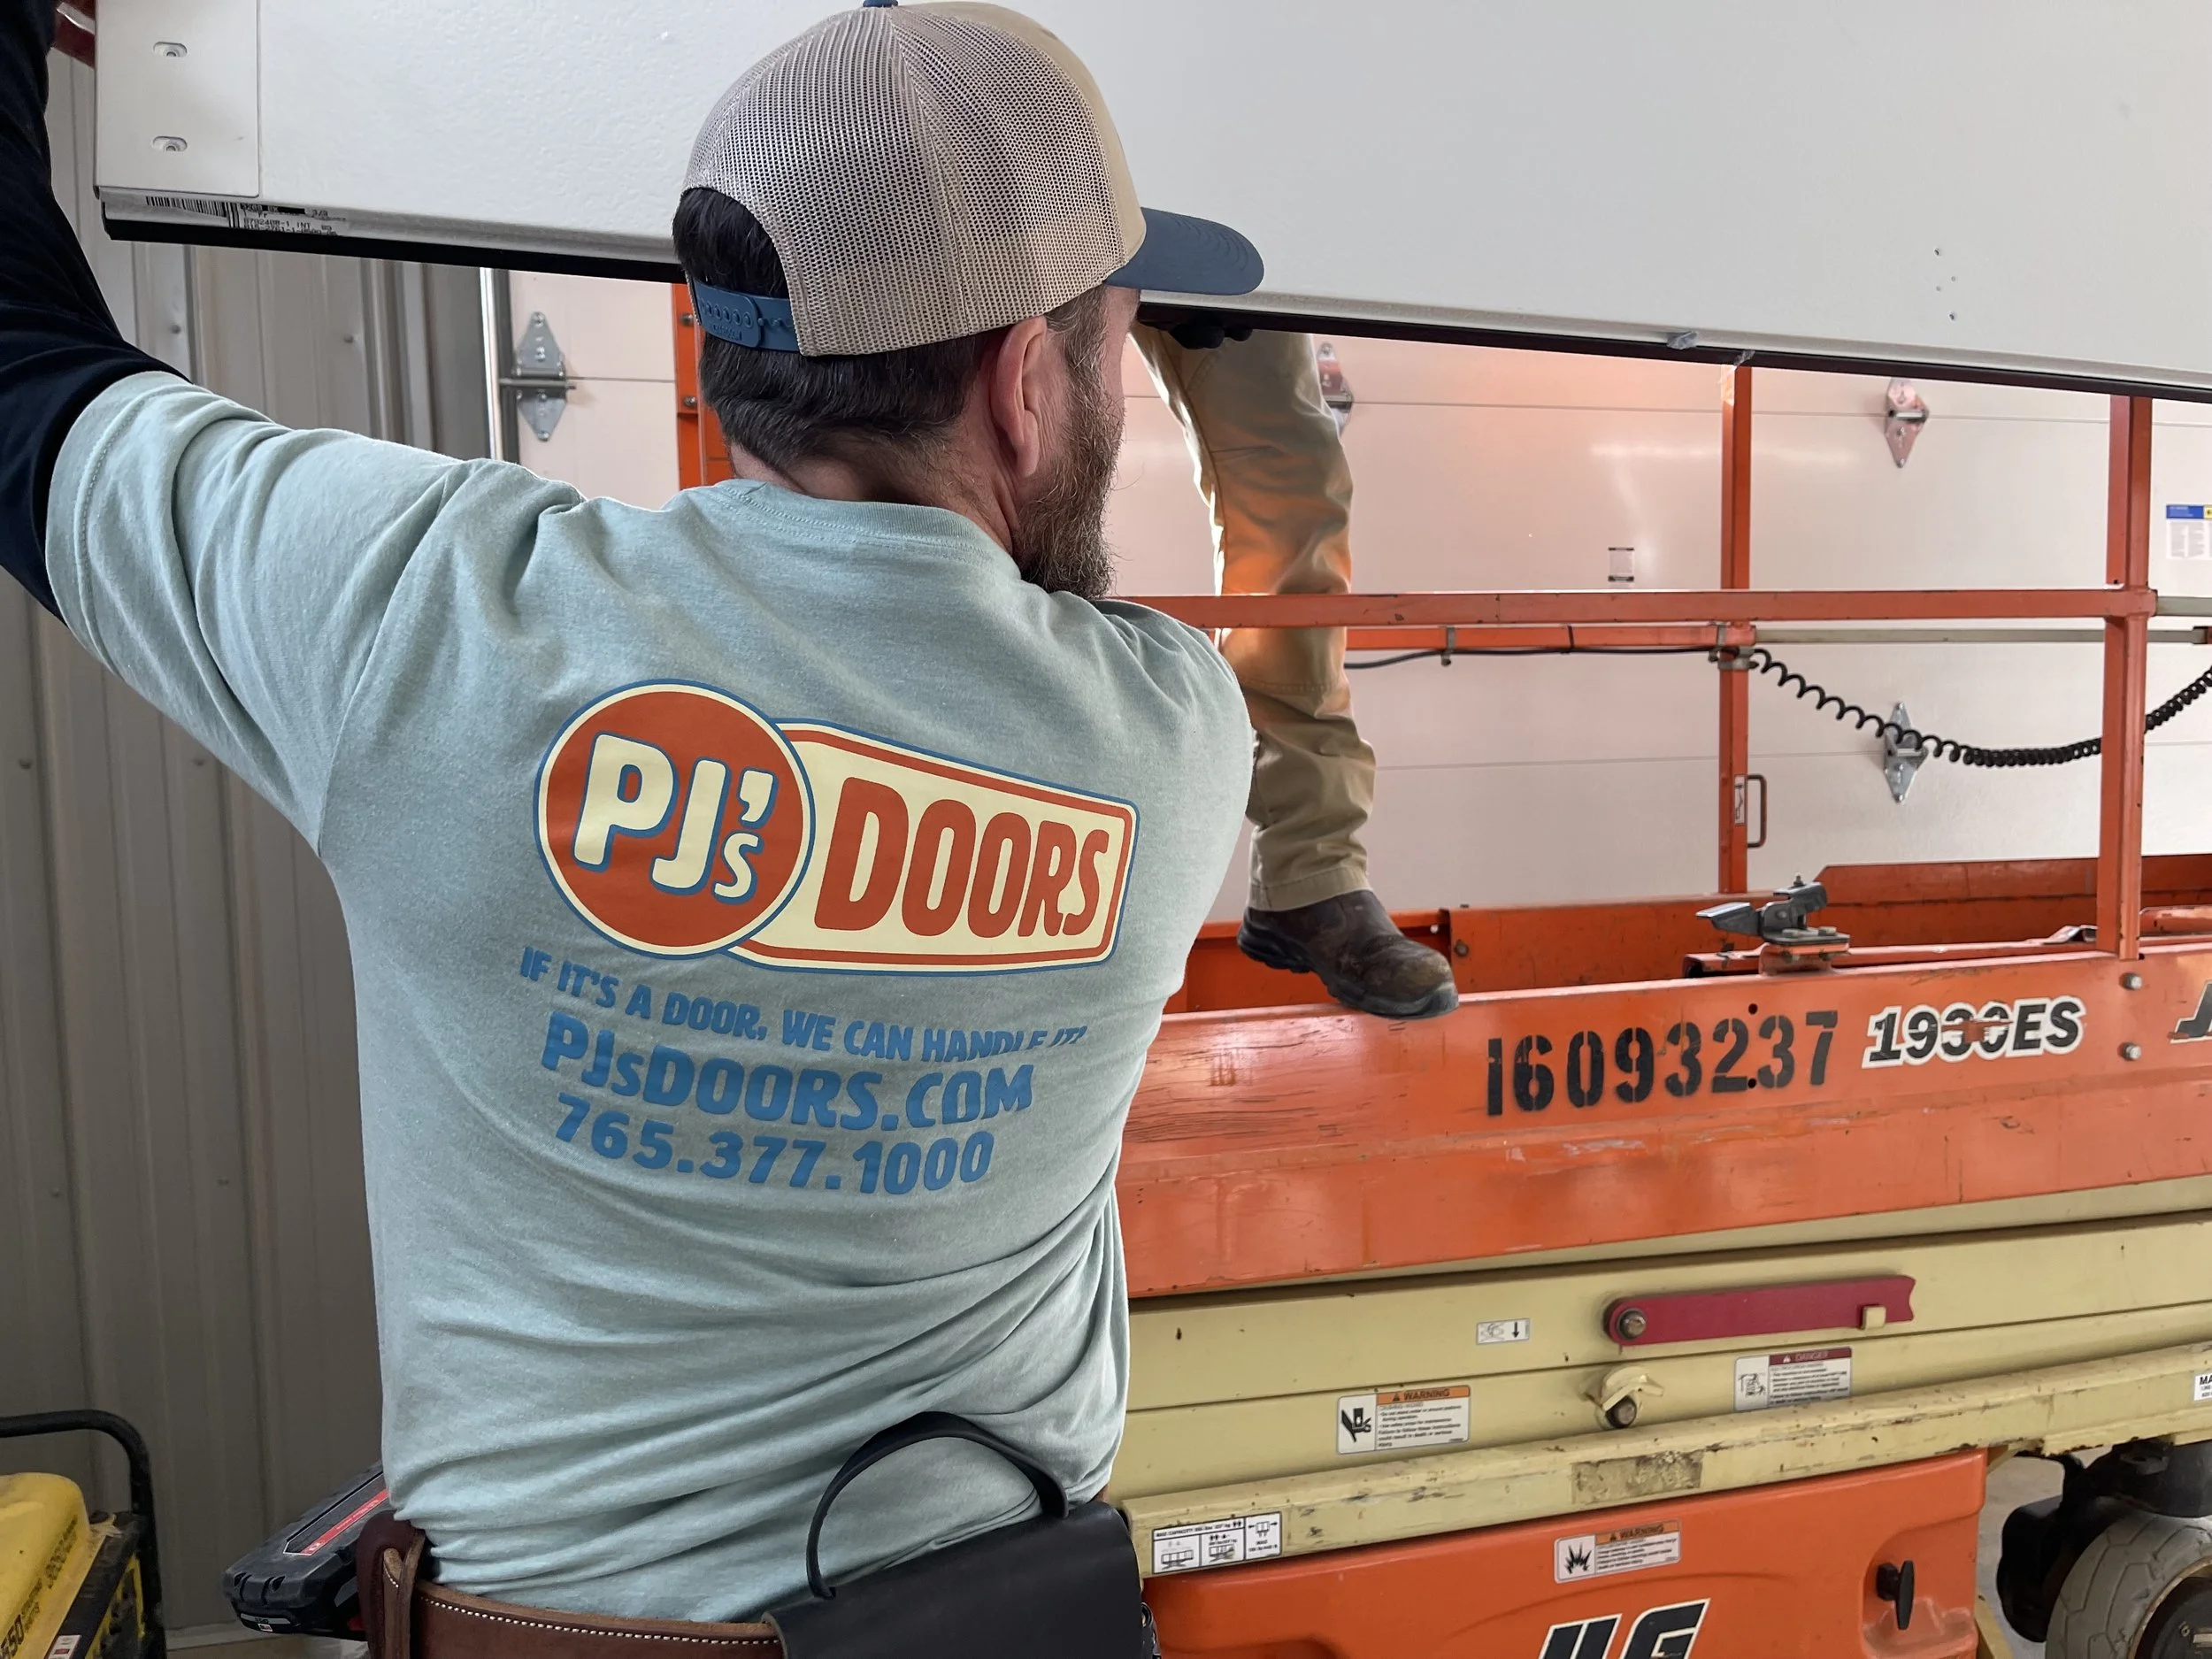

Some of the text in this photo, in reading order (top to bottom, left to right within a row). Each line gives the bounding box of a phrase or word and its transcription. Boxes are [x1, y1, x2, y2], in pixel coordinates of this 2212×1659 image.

[814, 777, 1110, 938] DOORS
[520, 946, 552, 981] IF
[557, 961, 618, 1008] IT'S
[625, 984, 652, 1019] A
[662, 991, 768, 1041] DOOR,
[782, 1008, 836, 1051] WE
[844, 1020, 913, 1061] CAN
[1487, 1010, 1839, 1117] 16093237
[554, 1093, 995, 1195] 765.377.1000
